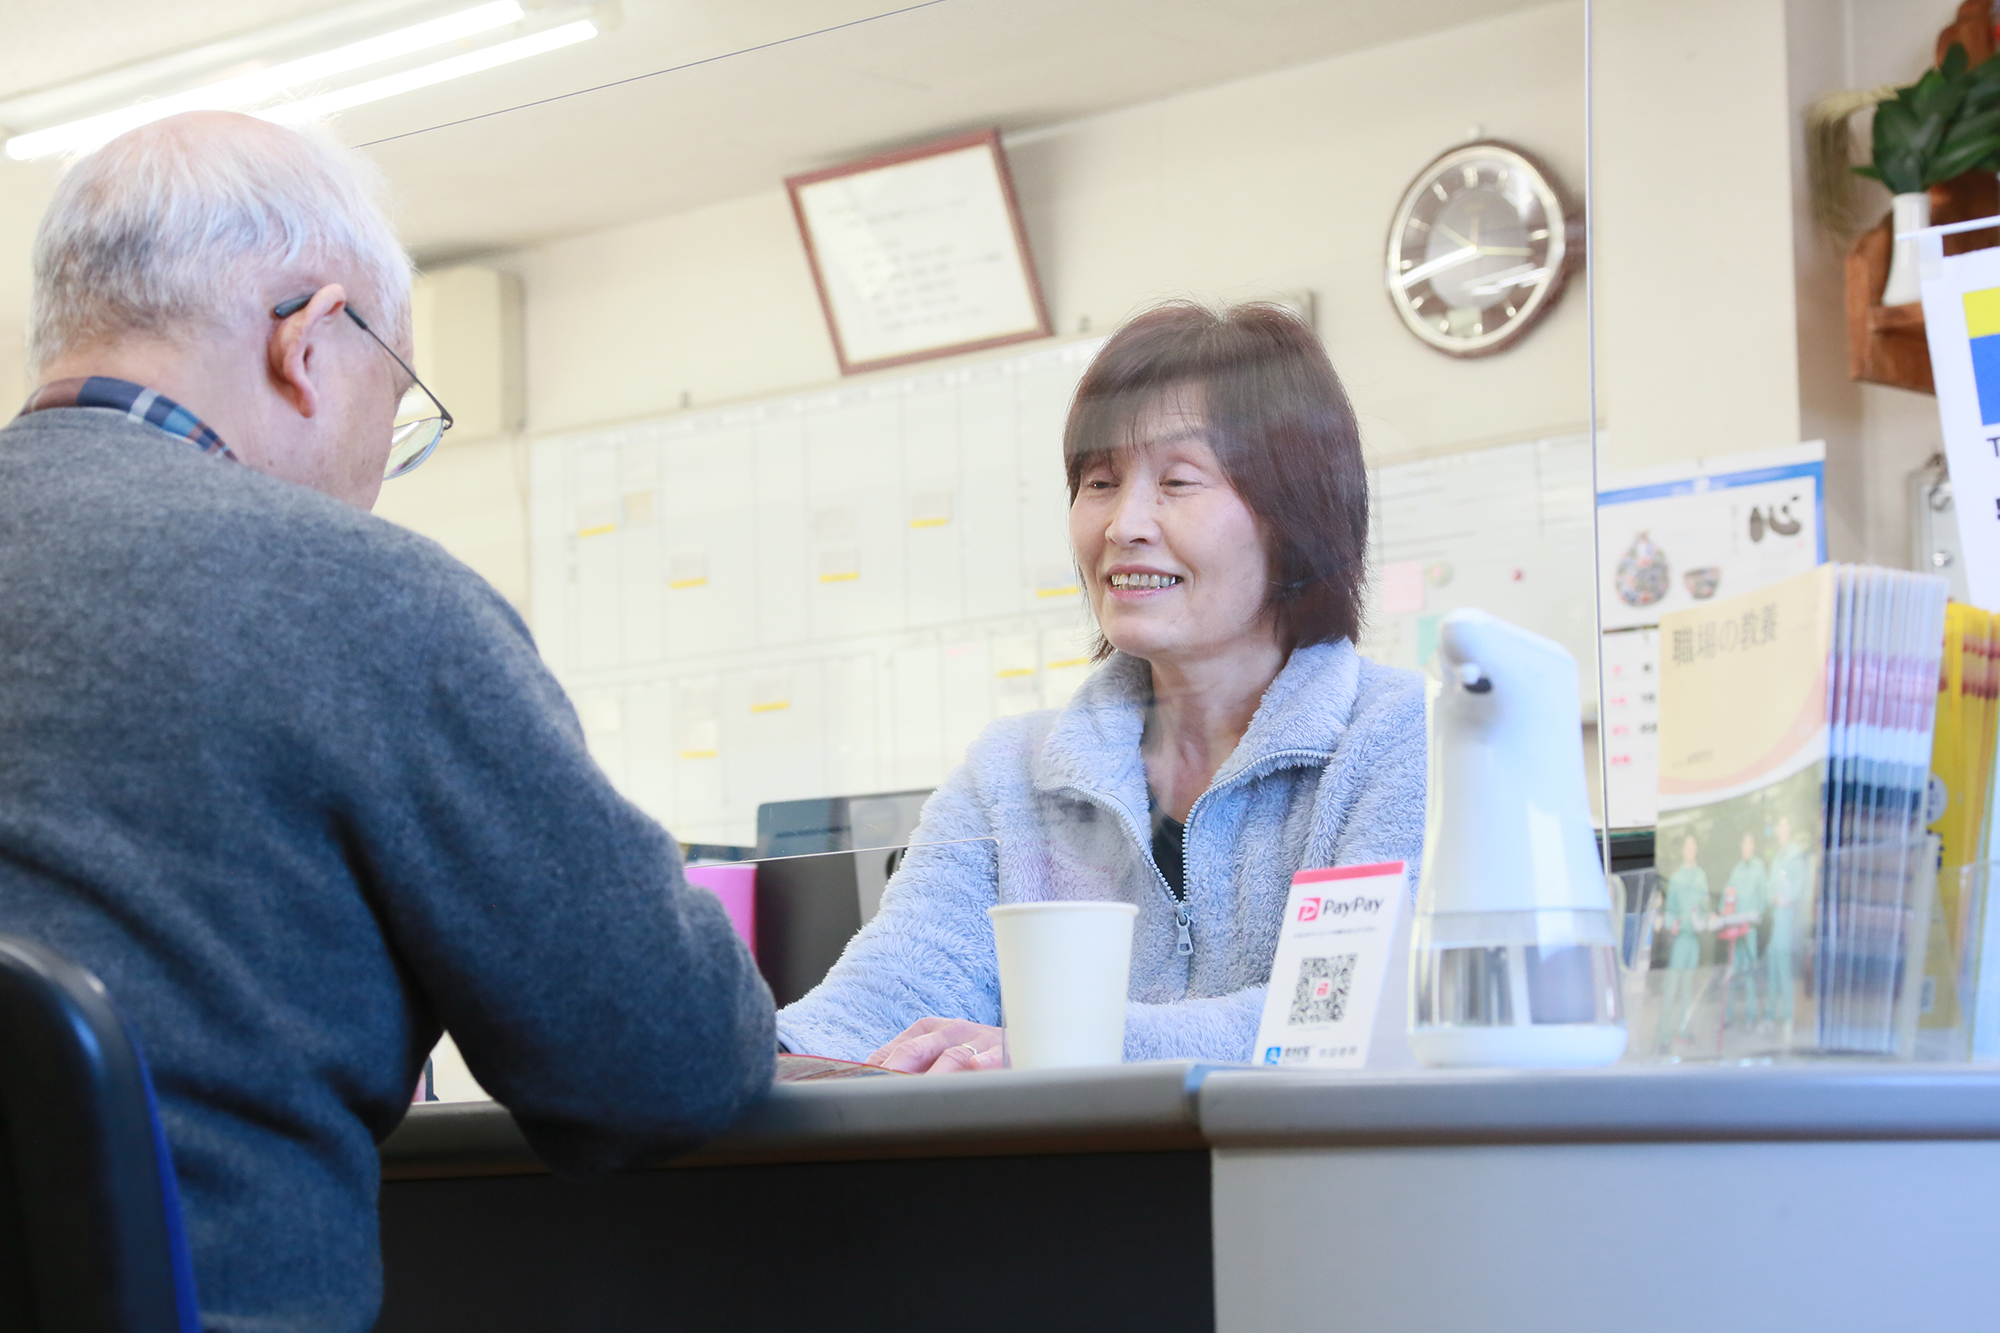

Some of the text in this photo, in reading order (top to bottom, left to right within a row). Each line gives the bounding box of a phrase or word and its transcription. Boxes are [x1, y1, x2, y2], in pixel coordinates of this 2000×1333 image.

[1672, 603, 1778, 666] 職場の教養
[1322, 896, 1384, 918] PayPay
